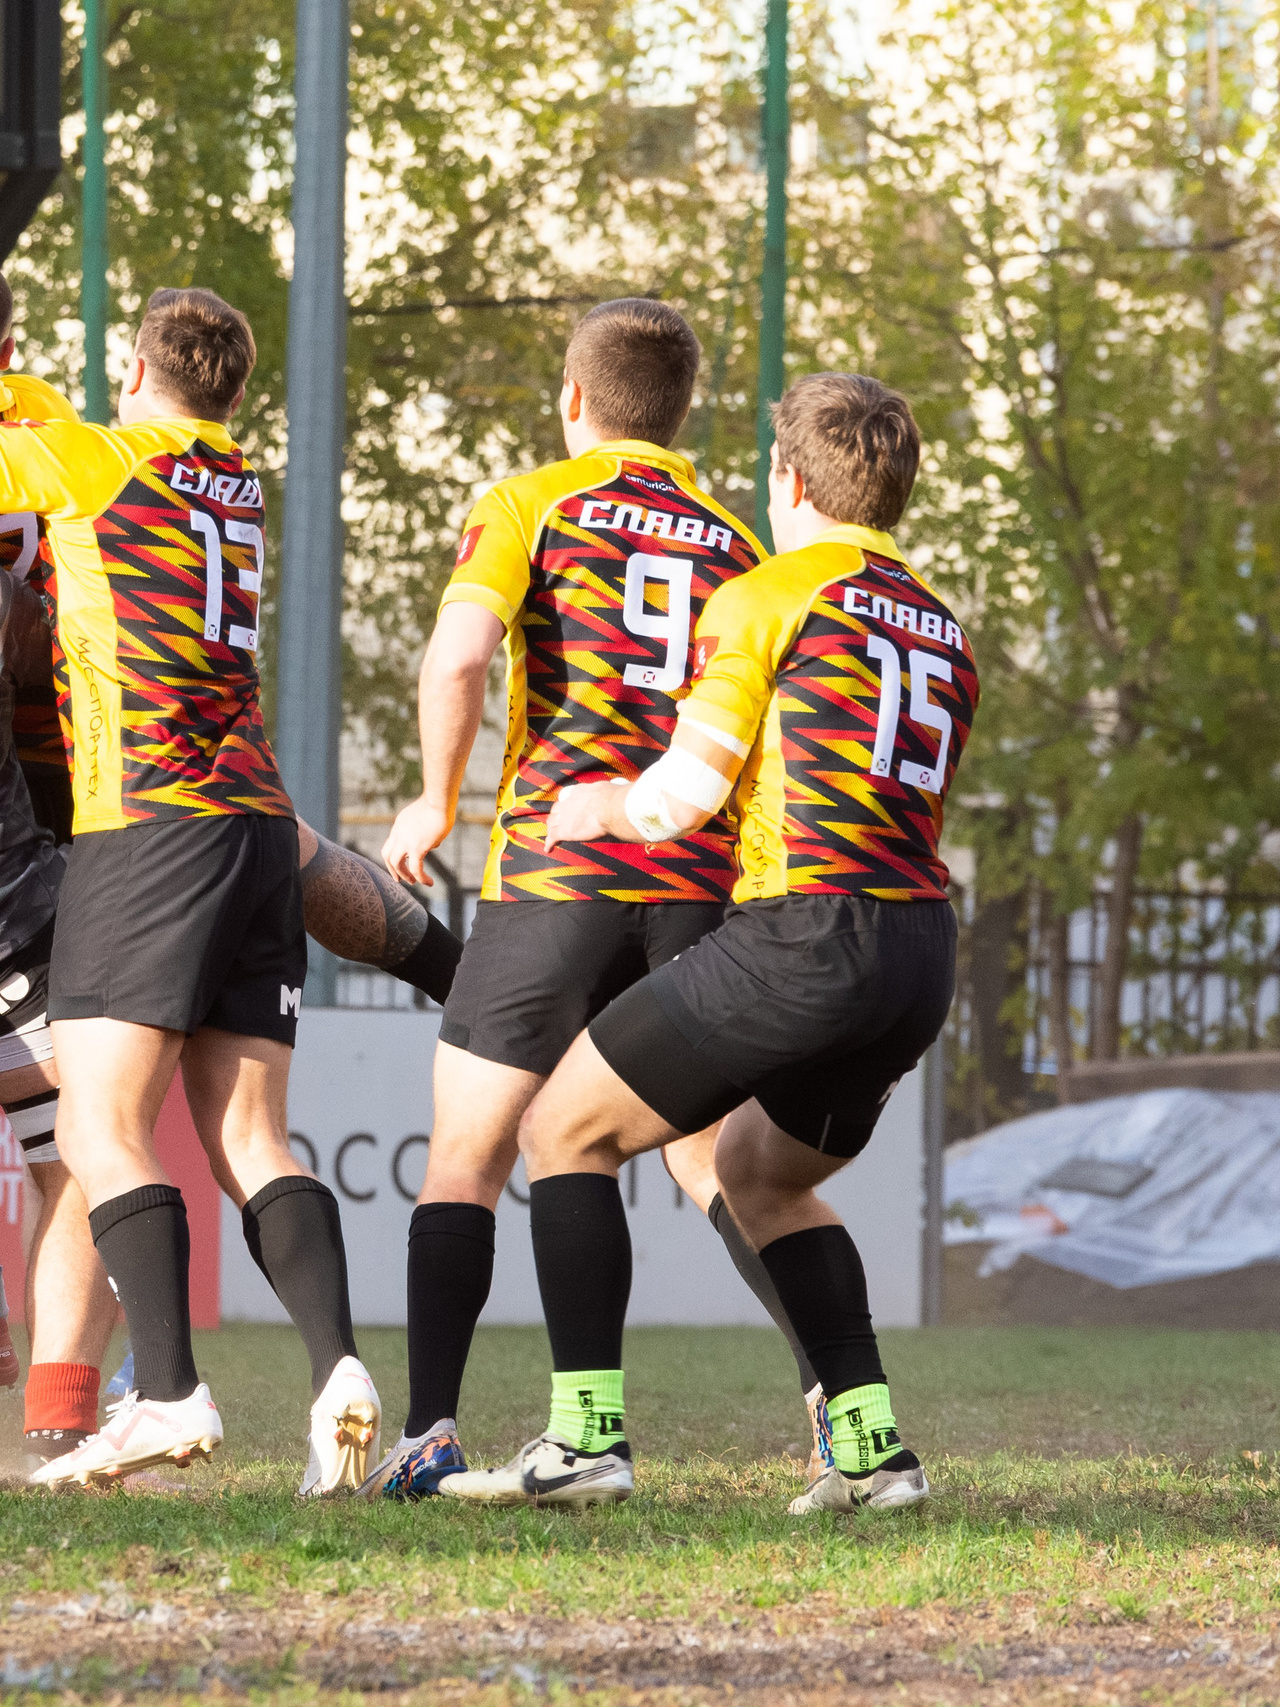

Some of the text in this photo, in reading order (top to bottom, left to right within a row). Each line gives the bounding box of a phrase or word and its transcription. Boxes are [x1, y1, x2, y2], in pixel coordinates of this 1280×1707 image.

[578, 500, 733, 552] СЛАВА
[625, 474, 675, 492] centurion
[190, 509, 263, 652] 13
[623, 552, 693, 692] 9
[843, 586, 963, 651] СЛАВА
[866, 635, 953, 795] 15
